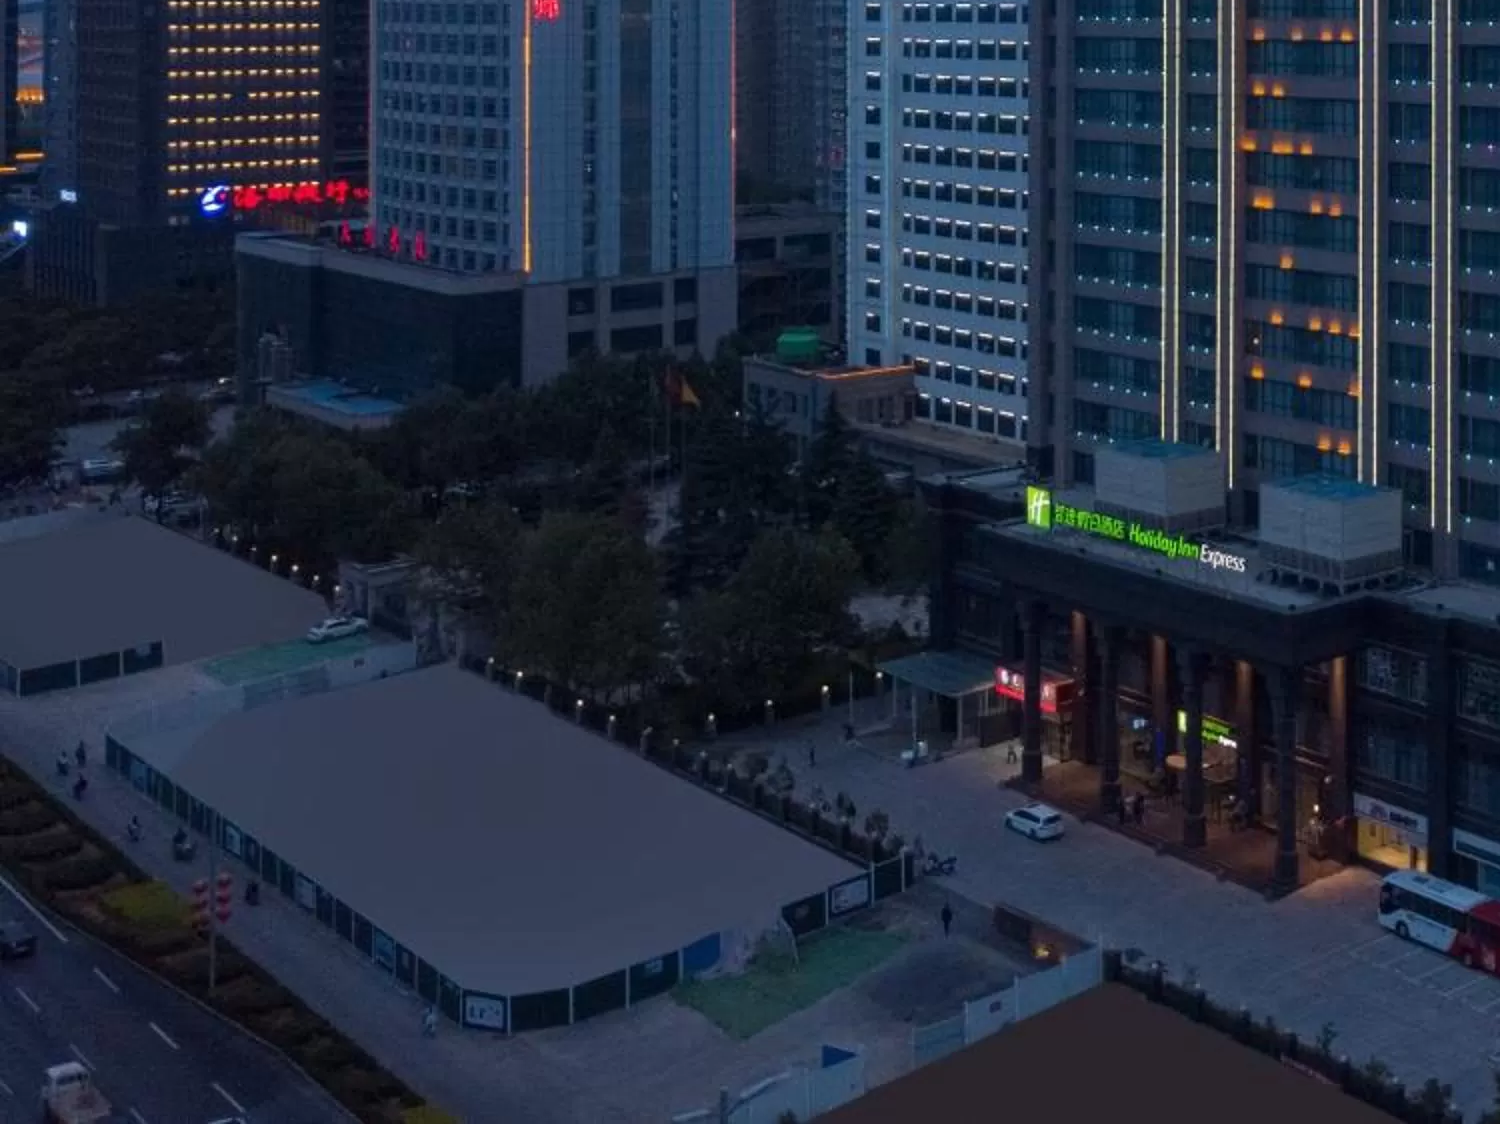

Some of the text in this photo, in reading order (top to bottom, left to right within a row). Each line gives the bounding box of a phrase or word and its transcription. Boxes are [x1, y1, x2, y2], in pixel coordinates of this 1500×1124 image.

[1129, 523, 1247, 573] Holiday Inn Express
